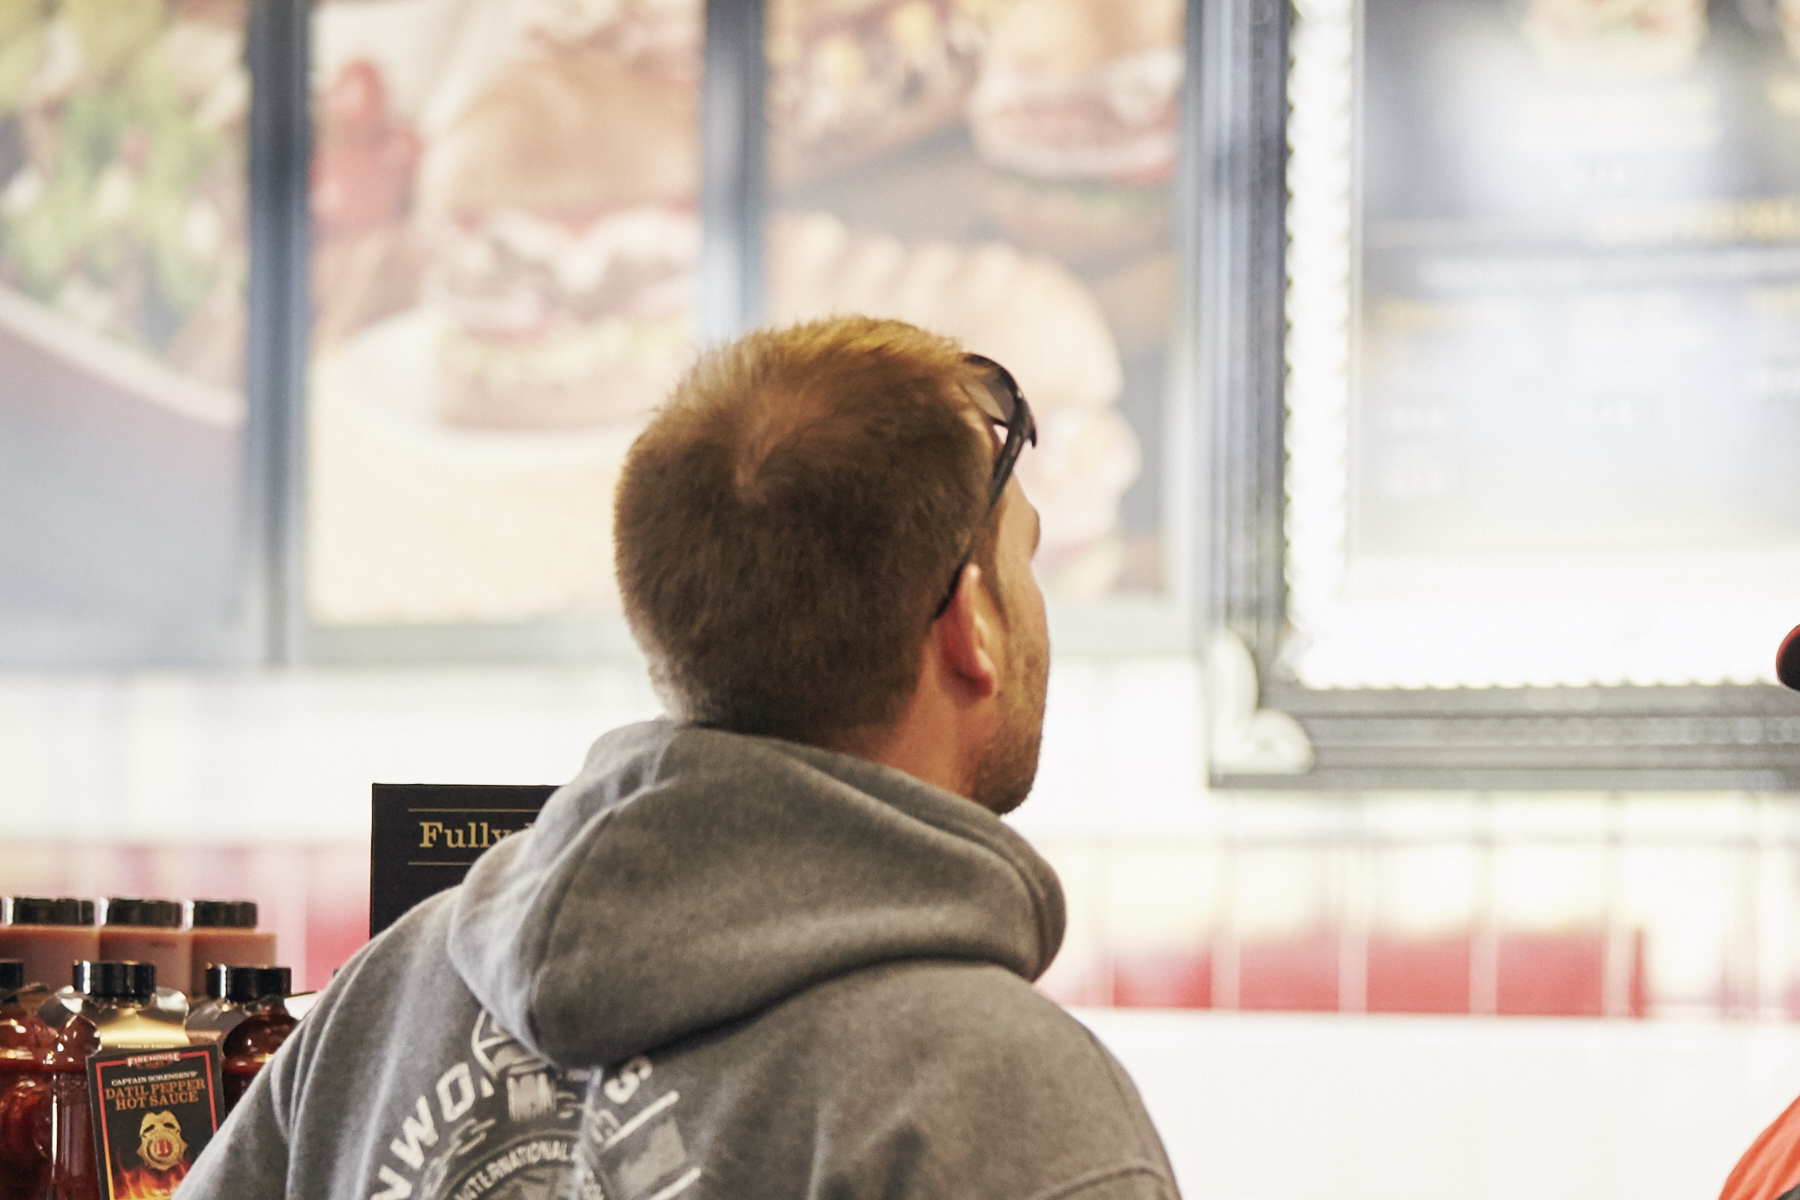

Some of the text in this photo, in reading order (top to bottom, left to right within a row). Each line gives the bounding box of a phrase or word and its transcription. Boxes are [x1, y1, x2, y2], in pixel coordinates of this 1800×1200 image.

[105, 1078, 206, 1100] DATIL PEPPER
[116, 1090, 199, 1111] HOT SAUCE
